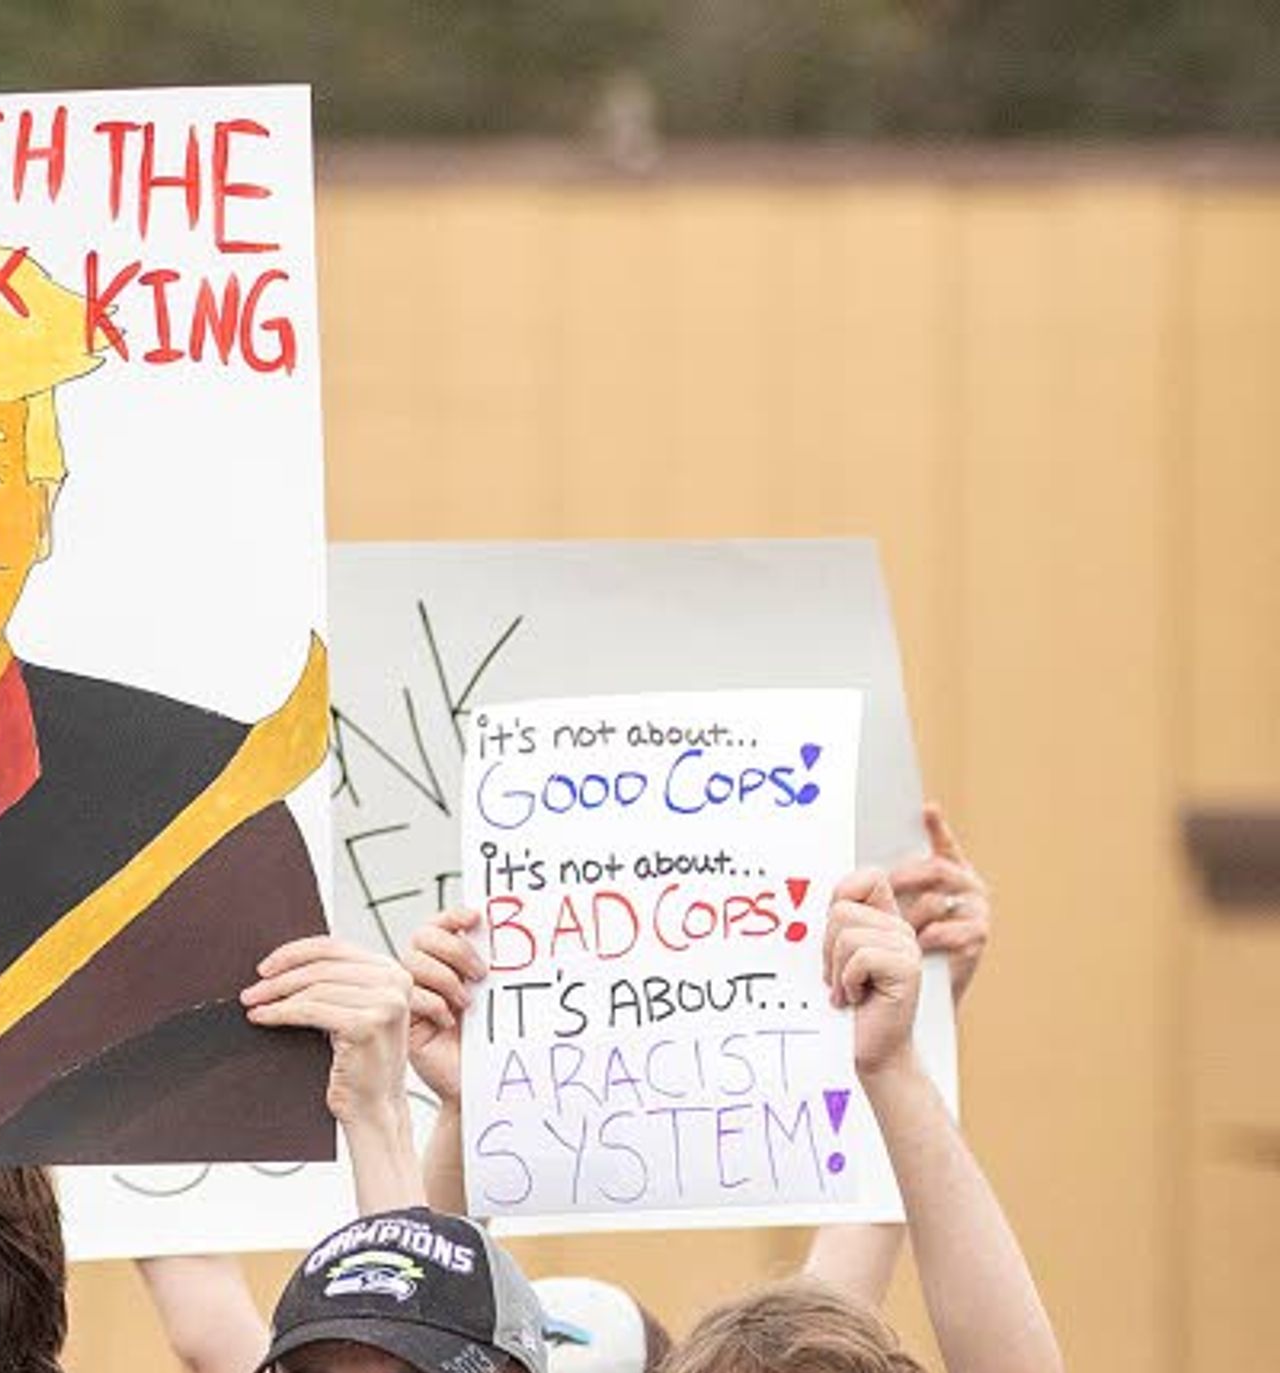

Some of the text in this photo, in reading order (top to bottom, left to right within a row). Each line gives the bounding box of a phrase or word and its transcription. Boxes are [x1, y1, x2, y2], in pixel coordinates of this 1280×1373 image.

[96, 119, 281, 253] THE
[84, 249, 297, 378] KING
[476, 714, 758, 759] it's not about...
[480, 842, 766, 896] it's not about...
[486, 891, 639, 972] BAD
[486, 970, 809, 1044] IT'S ABOUT...
[476, 1088, 852, 1206] SYSTEM!
[304, 1220, 477, 1276] CHAMPIONS
